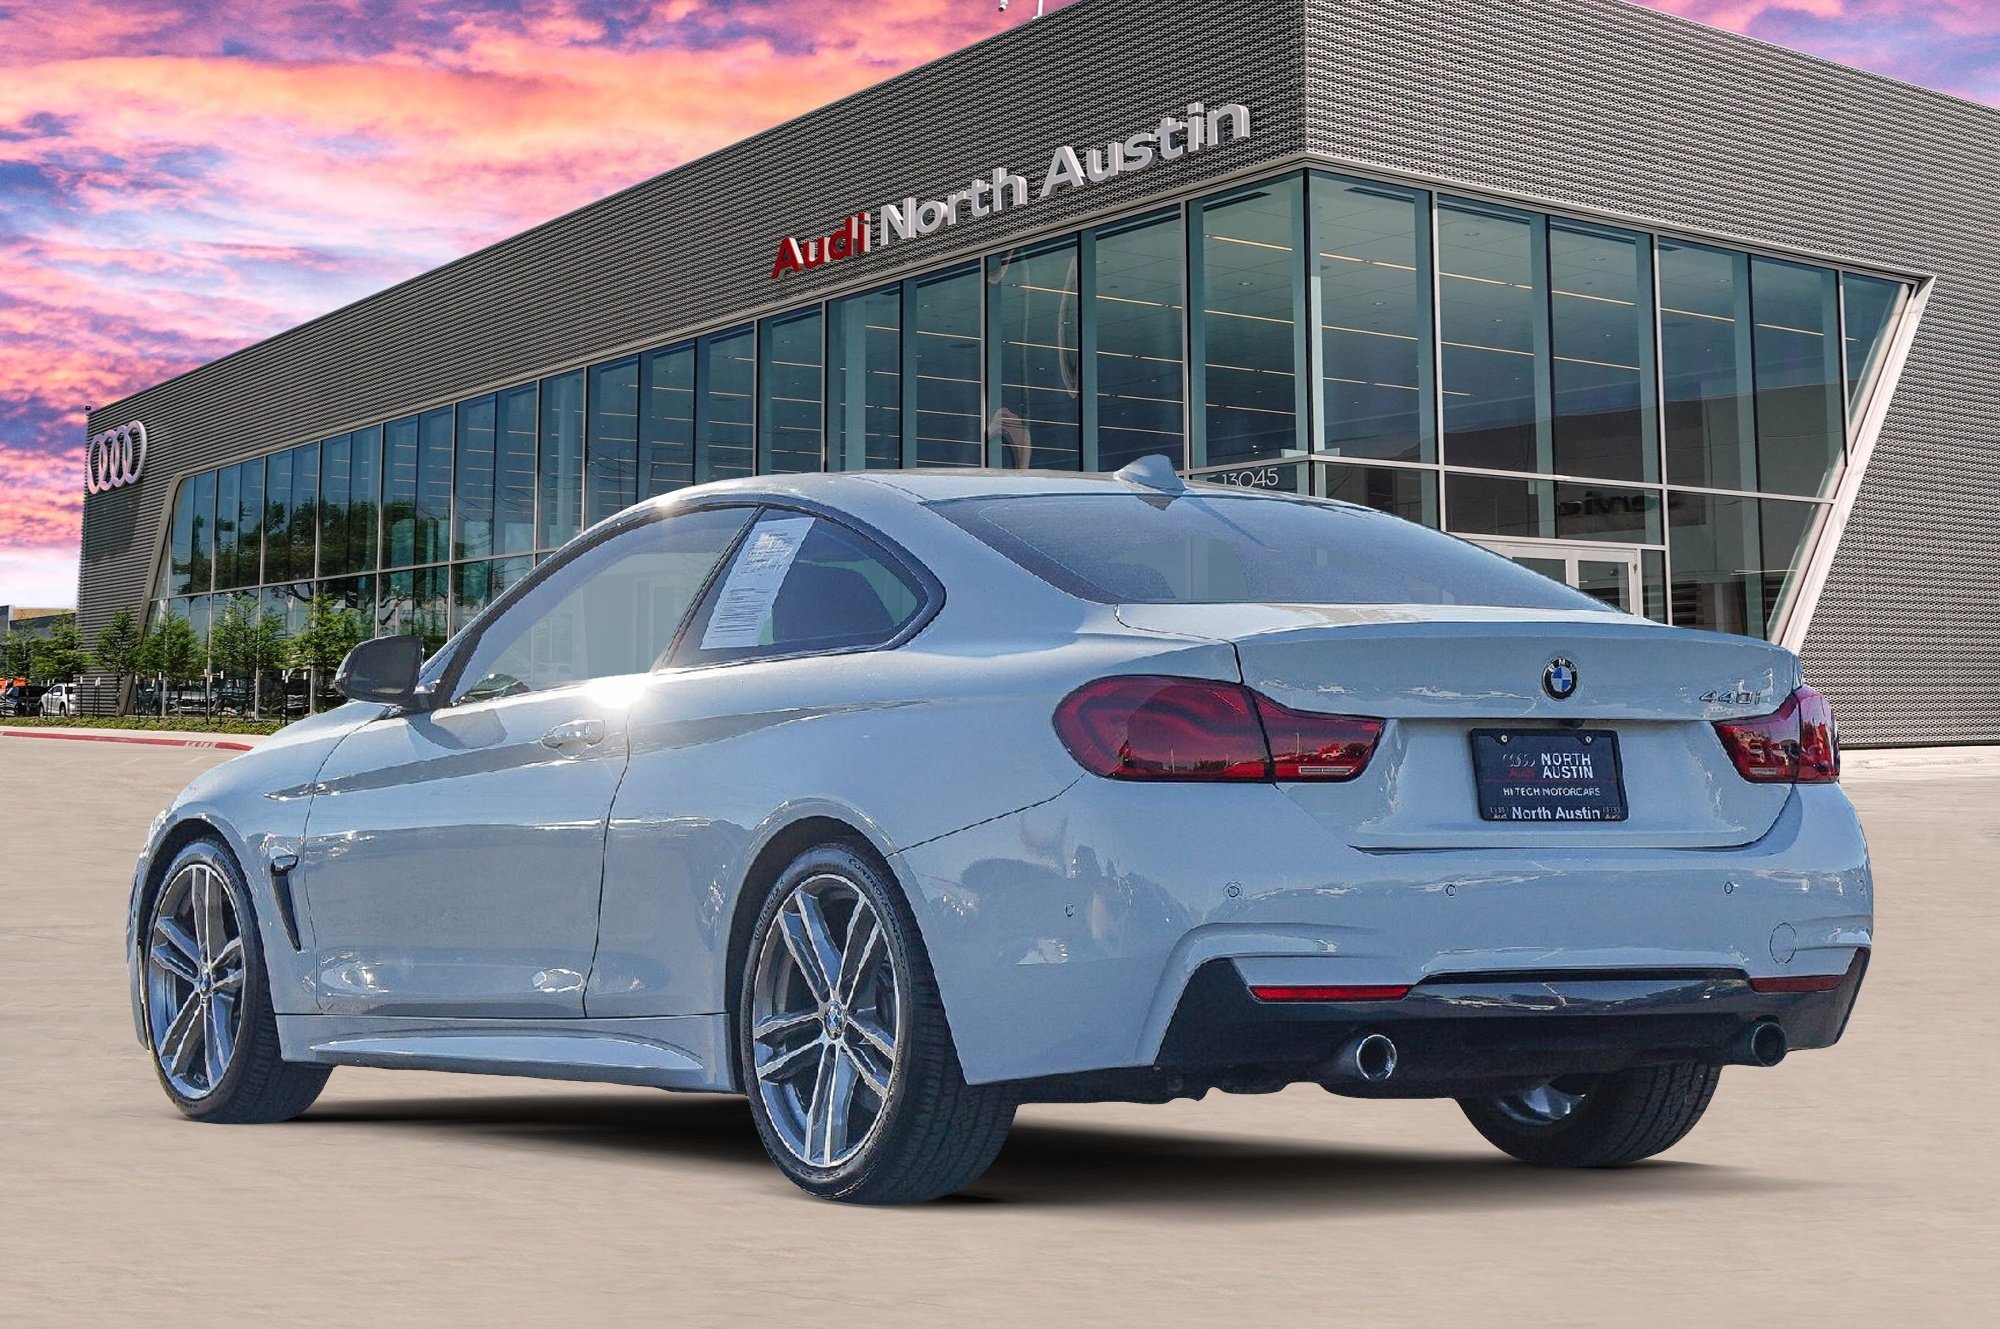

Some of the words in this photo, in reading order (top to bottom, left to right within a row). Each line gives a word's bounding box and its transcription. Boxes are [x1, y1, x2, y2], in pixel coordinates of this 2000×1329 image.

[771, 212, 872, 279] Audi
[879, 166, 1029, 246] North
[1039, 101, 1252, 198] Austin
[1222, 467, 1279, 488] 13045
[1541, 753, 1591, 766] NORTH
[1542, 766, 1594, 779] AUSTIN
[1503, 787, 1514, 796] HI
[1515, 787, 1540, 796] TECH
[1512, 806, 1551, 819] North
[1555, 806, 1601, 819] Austin
